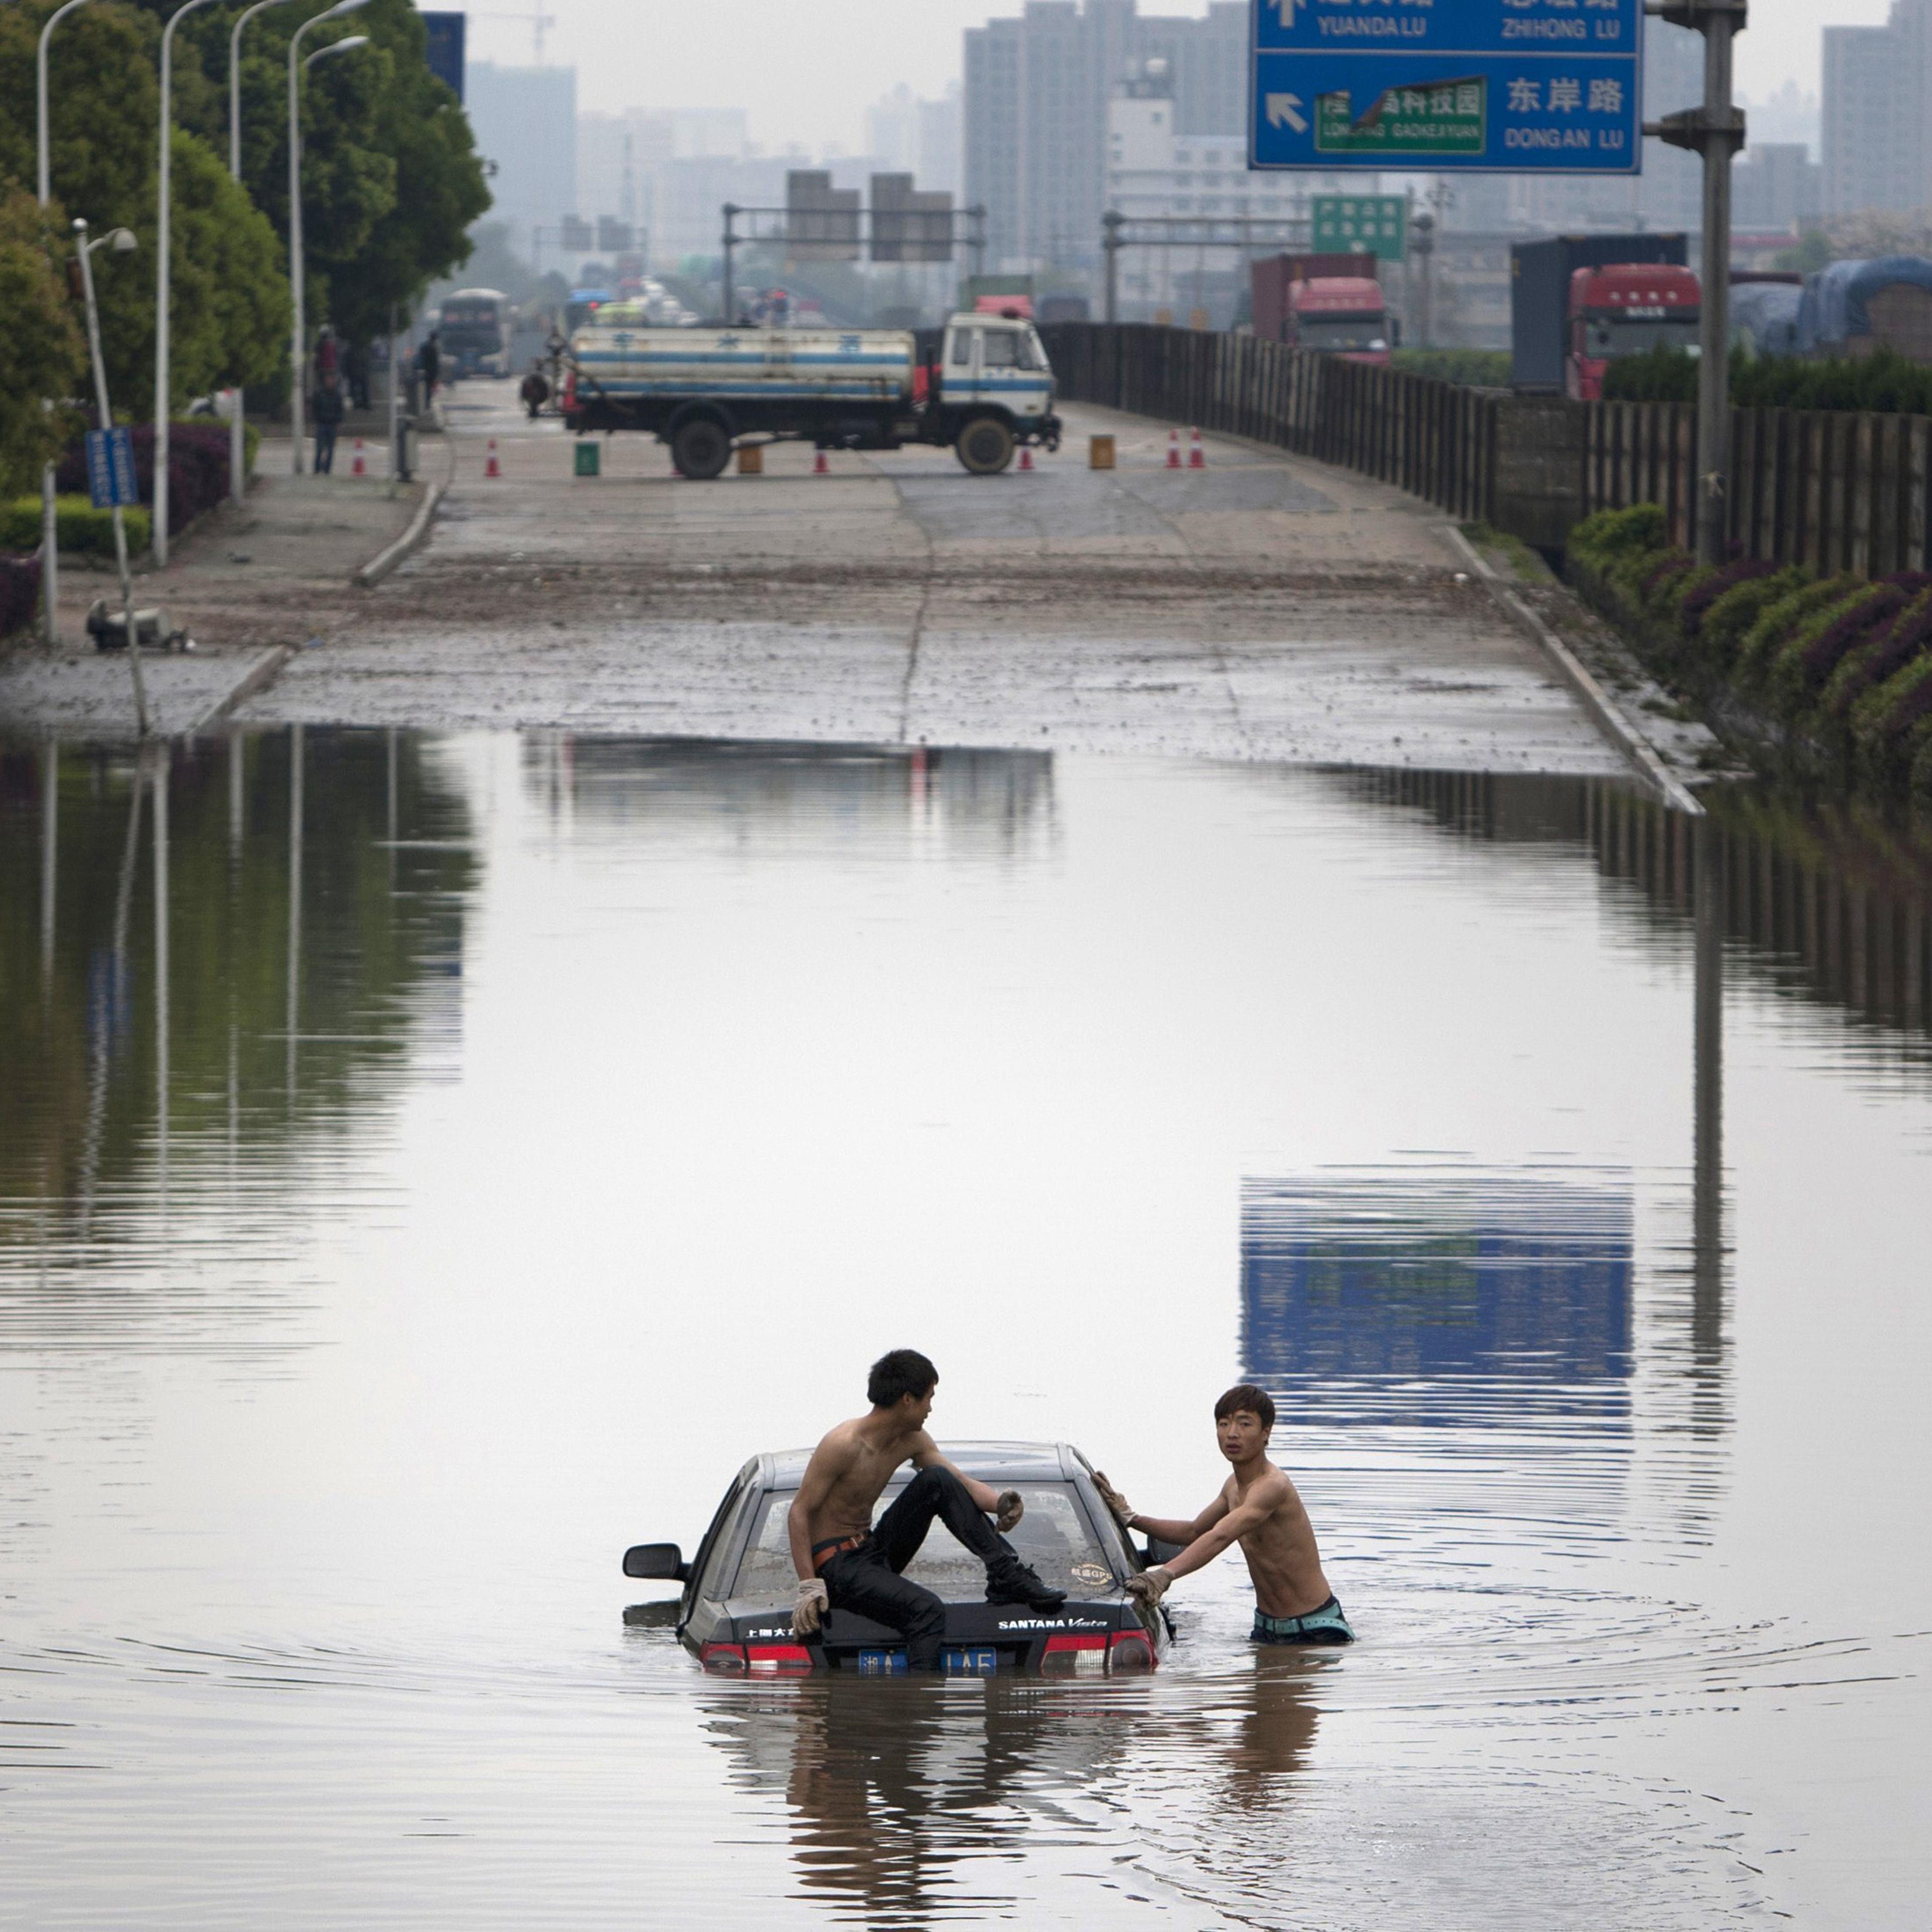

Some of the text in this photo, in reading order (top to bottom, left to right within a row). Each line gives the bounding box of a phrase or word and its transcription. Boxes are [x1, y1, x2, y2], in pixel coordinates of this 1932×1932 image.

[1317, 16, 1426, 37] YUANDA LU
[1501, 18, 1620, 39] ZHIHONG LU
[1506, 77, 1623, 113] 东岸路
[1598, 129, 1624, 149] LU
[998, 1618, 1107, 1630] SANTANA Vista
